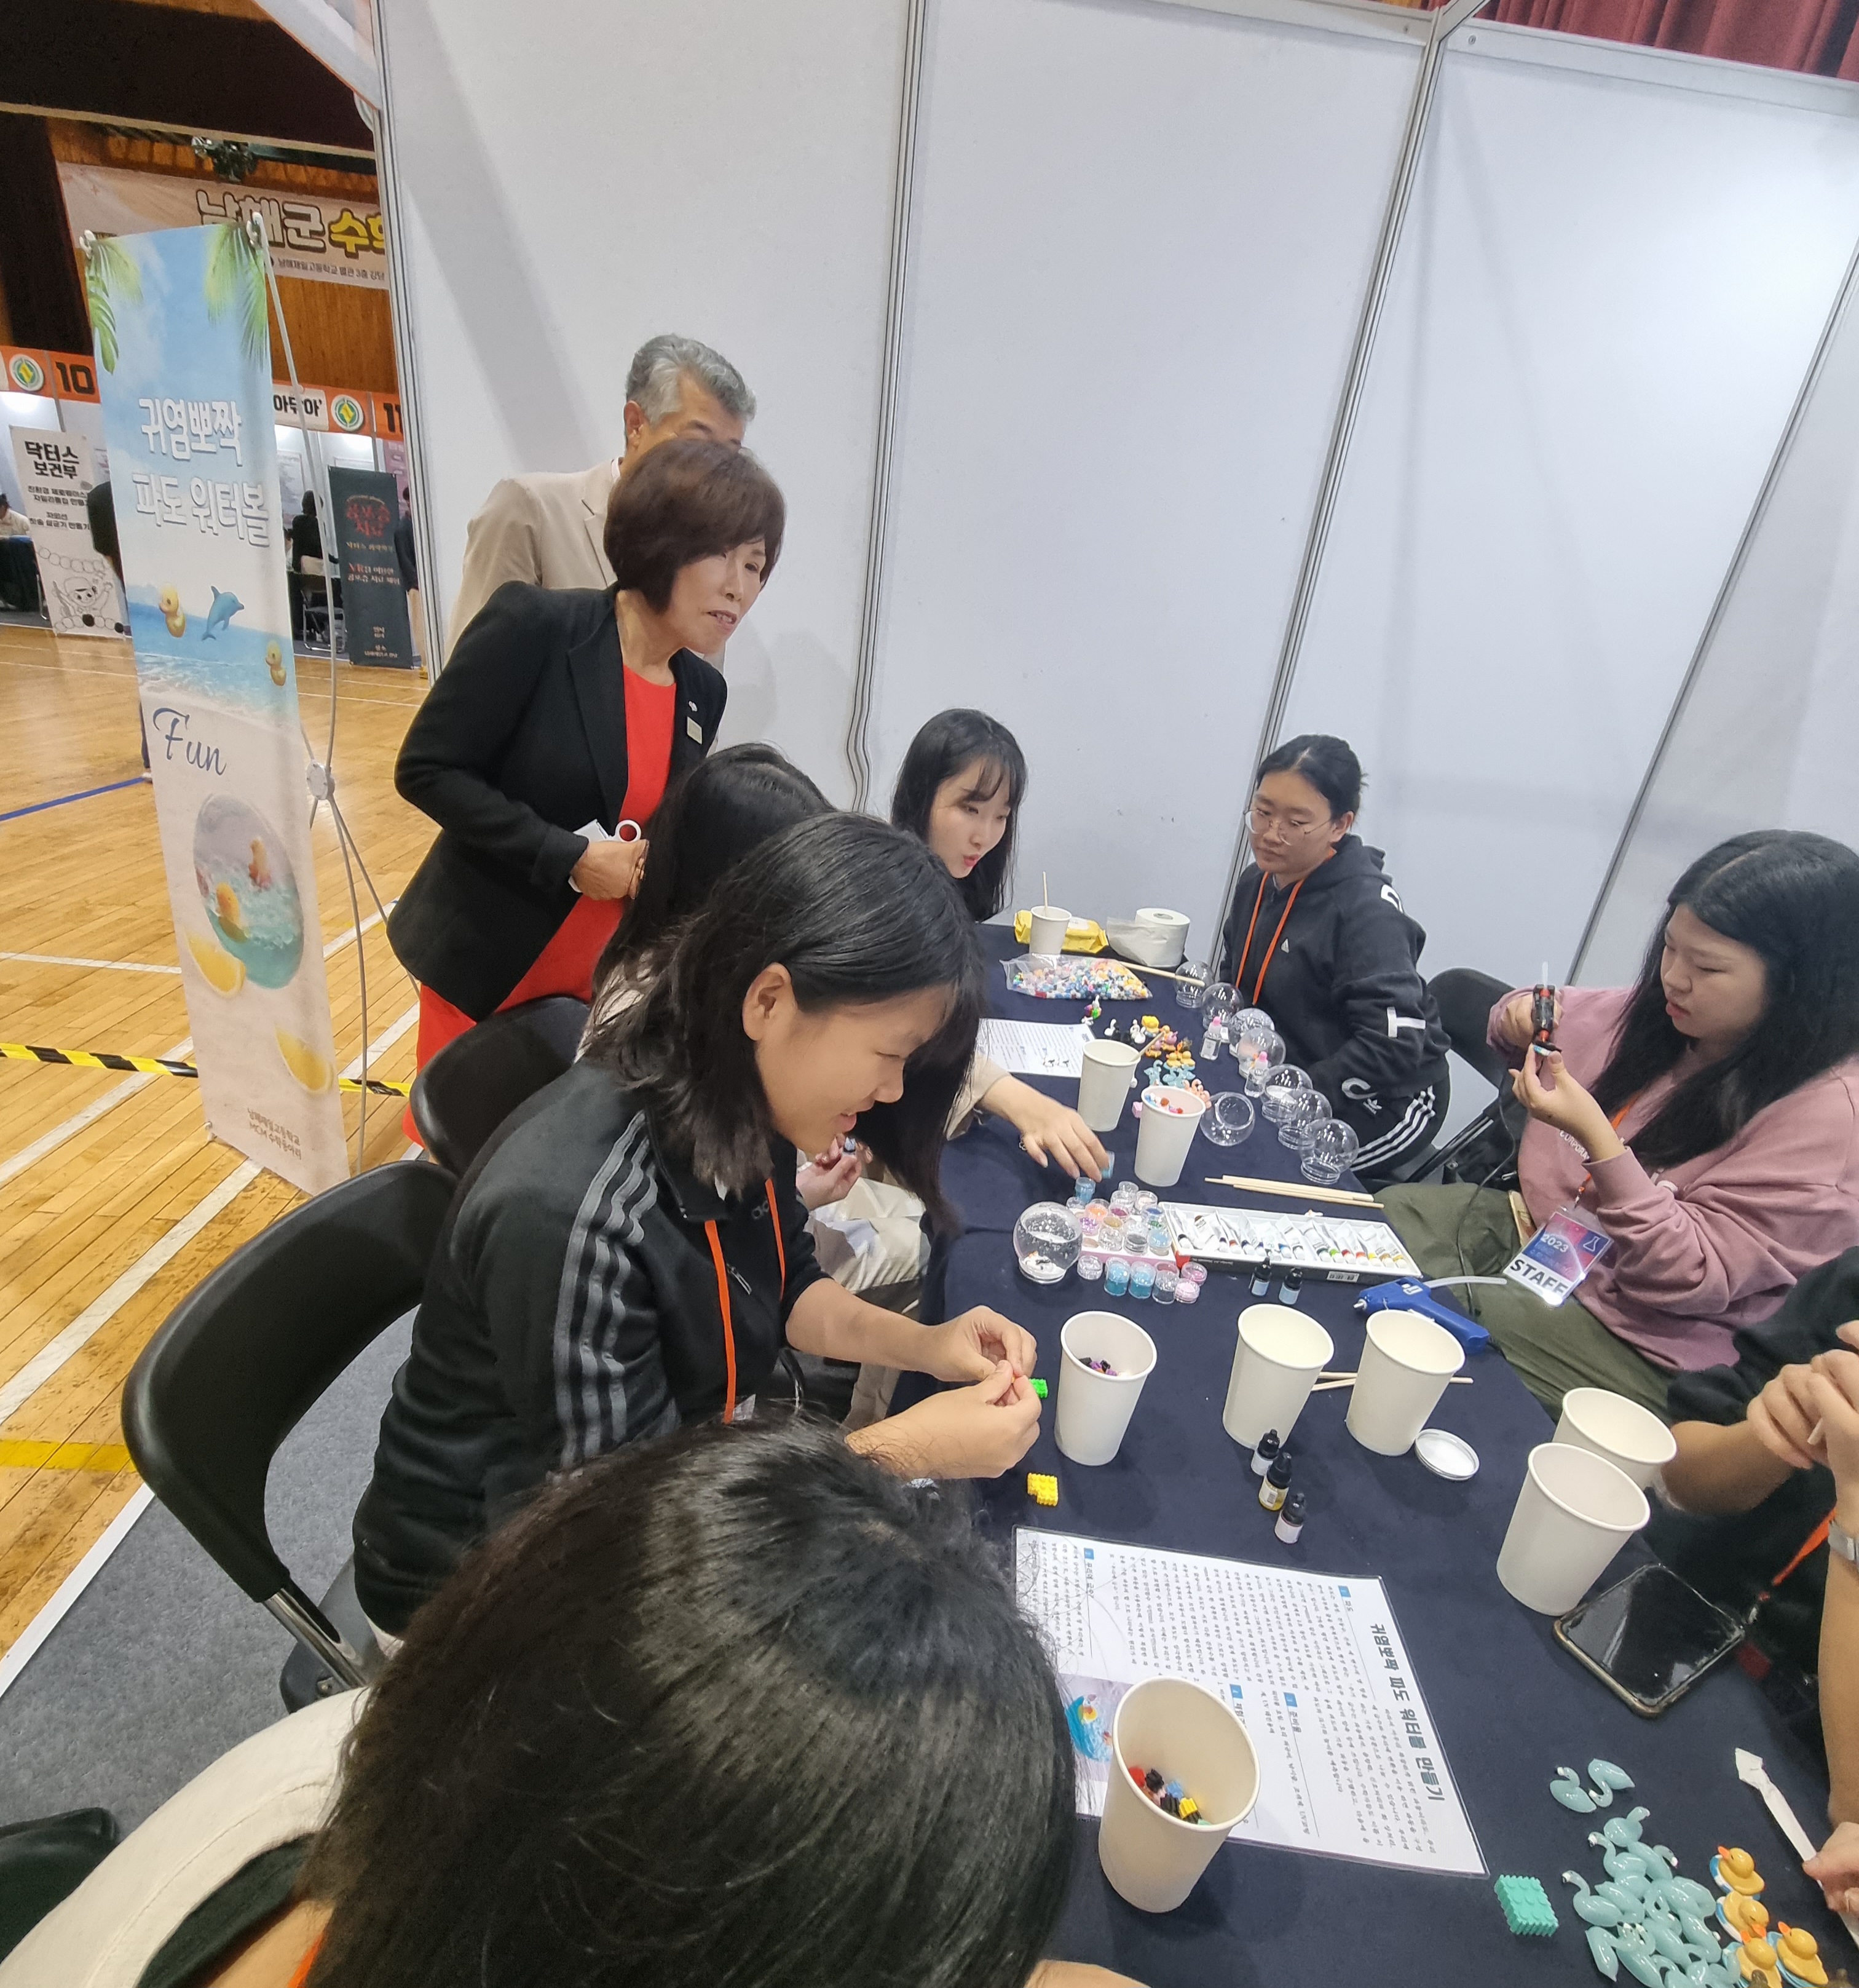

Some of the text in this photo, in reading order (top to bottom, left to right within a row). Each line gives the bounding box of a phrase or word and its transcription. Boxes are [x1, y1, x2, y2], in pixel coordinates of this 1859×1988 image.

[55, 361, 95, 395] 10
[139, 398, 243, 467] 귀염뽀짝
[25, 441, 79, 464] 닥터스
[33, 460, 77, 480] 보건부
[133, 473, 270, 547] 파도 워터볼
[153, 708, 227, 775] Fun
[1540, 1234, 1569, 1253] 2023
[1510, 1259, 1569, 1294] STAFF
[1370, 1623, 1445, 1801] 귀염뽀짝 파도 워터볼 만들기
